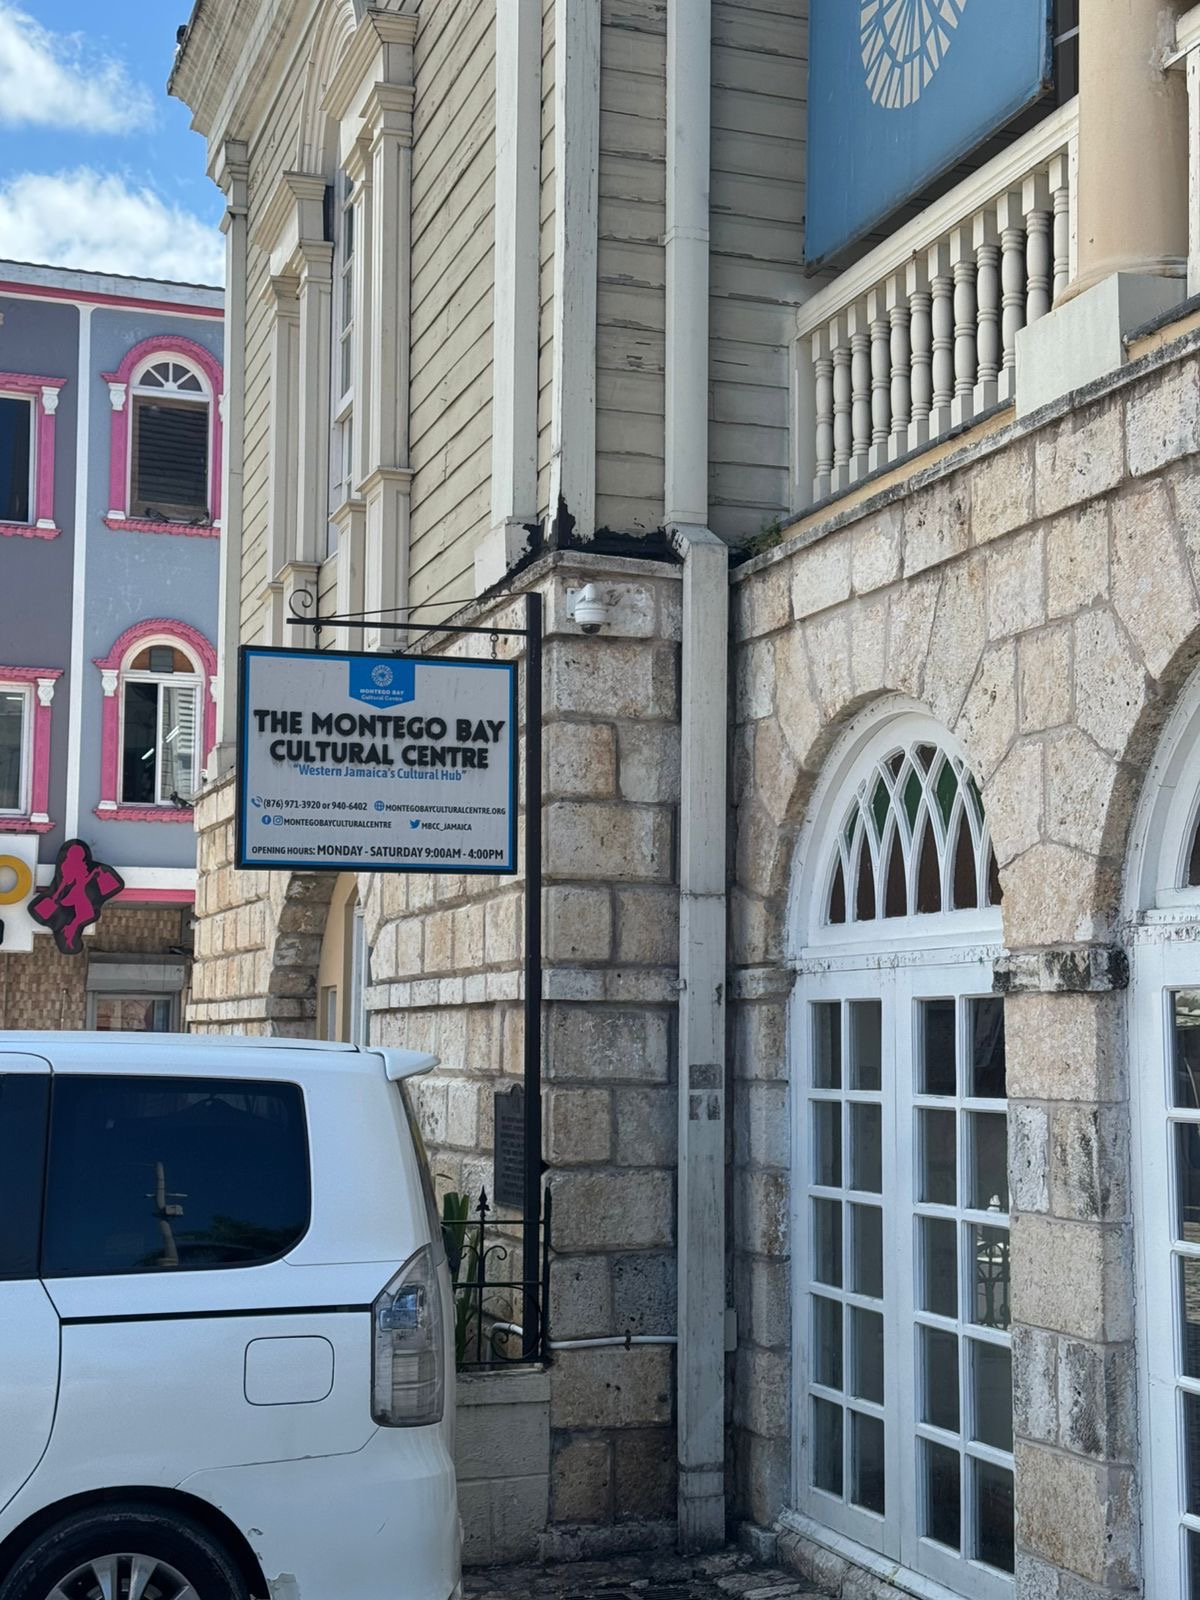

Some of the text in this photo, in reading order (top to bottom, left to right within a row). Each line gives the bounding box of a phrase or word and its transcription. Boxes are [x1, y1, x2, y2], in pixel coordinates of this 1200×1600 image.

[253, 709, 506, 743] THE MONTEGO BAY
[269, 739, 489, 769] CULTURAL CENTRE
[344, 766, 396, 779] Jamaica's
[397, 767, 439, 781] Cultural
[263, 798, 368, 811] (876) 971-3920 or 940-6402
[385, 804, 506, 815] MONTEGOBAYCULTURALCENTRE.ORG
[284, 818, 391, 828] MONTEGOBAYCULTURALCENTRE
[422, 822, 472, 831] MBCC_JAMAICA
[251, 846, 286, 855] OPENING
[286, 847, 316, 856] HOURS:
[317, 845, 363, 857] MONDAY
[370, 846, 423, 858] SATURDAY
[425, 848, 461, 859] 9:00AM
[468, 849, 503, 859] 4:00PM
